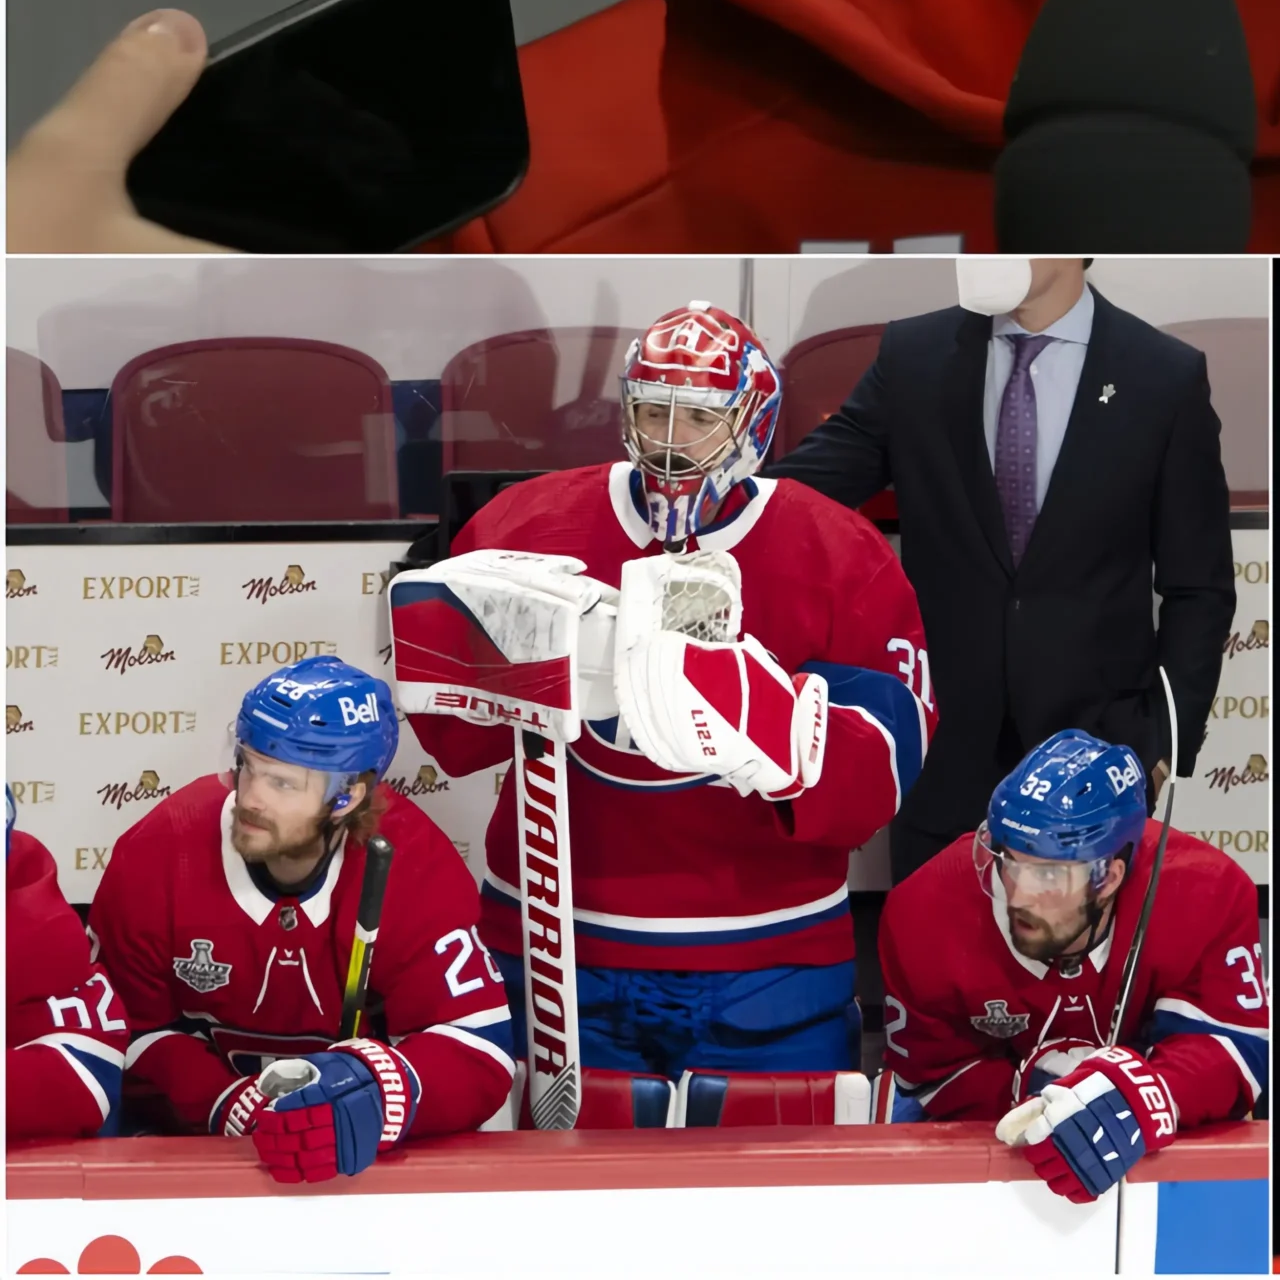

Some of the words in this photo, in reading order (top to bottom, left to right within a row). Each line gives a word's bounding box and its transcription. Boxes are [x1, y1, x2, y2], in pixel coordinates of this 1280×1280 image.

[646, 491, 690, 542] 31
[83, 576, 189, 600] EXPORT
[242, 577, 318, 605] Molson
[101, 646, 176, 676] Molson
[887, 637, 934, 713] 31
[79, 711, 184, 735] EXPORT
[338, 693, 380, 727] Bell
[1020, 773, 1052, 801] 32
[1106, 753, 1142, 796] Bell
